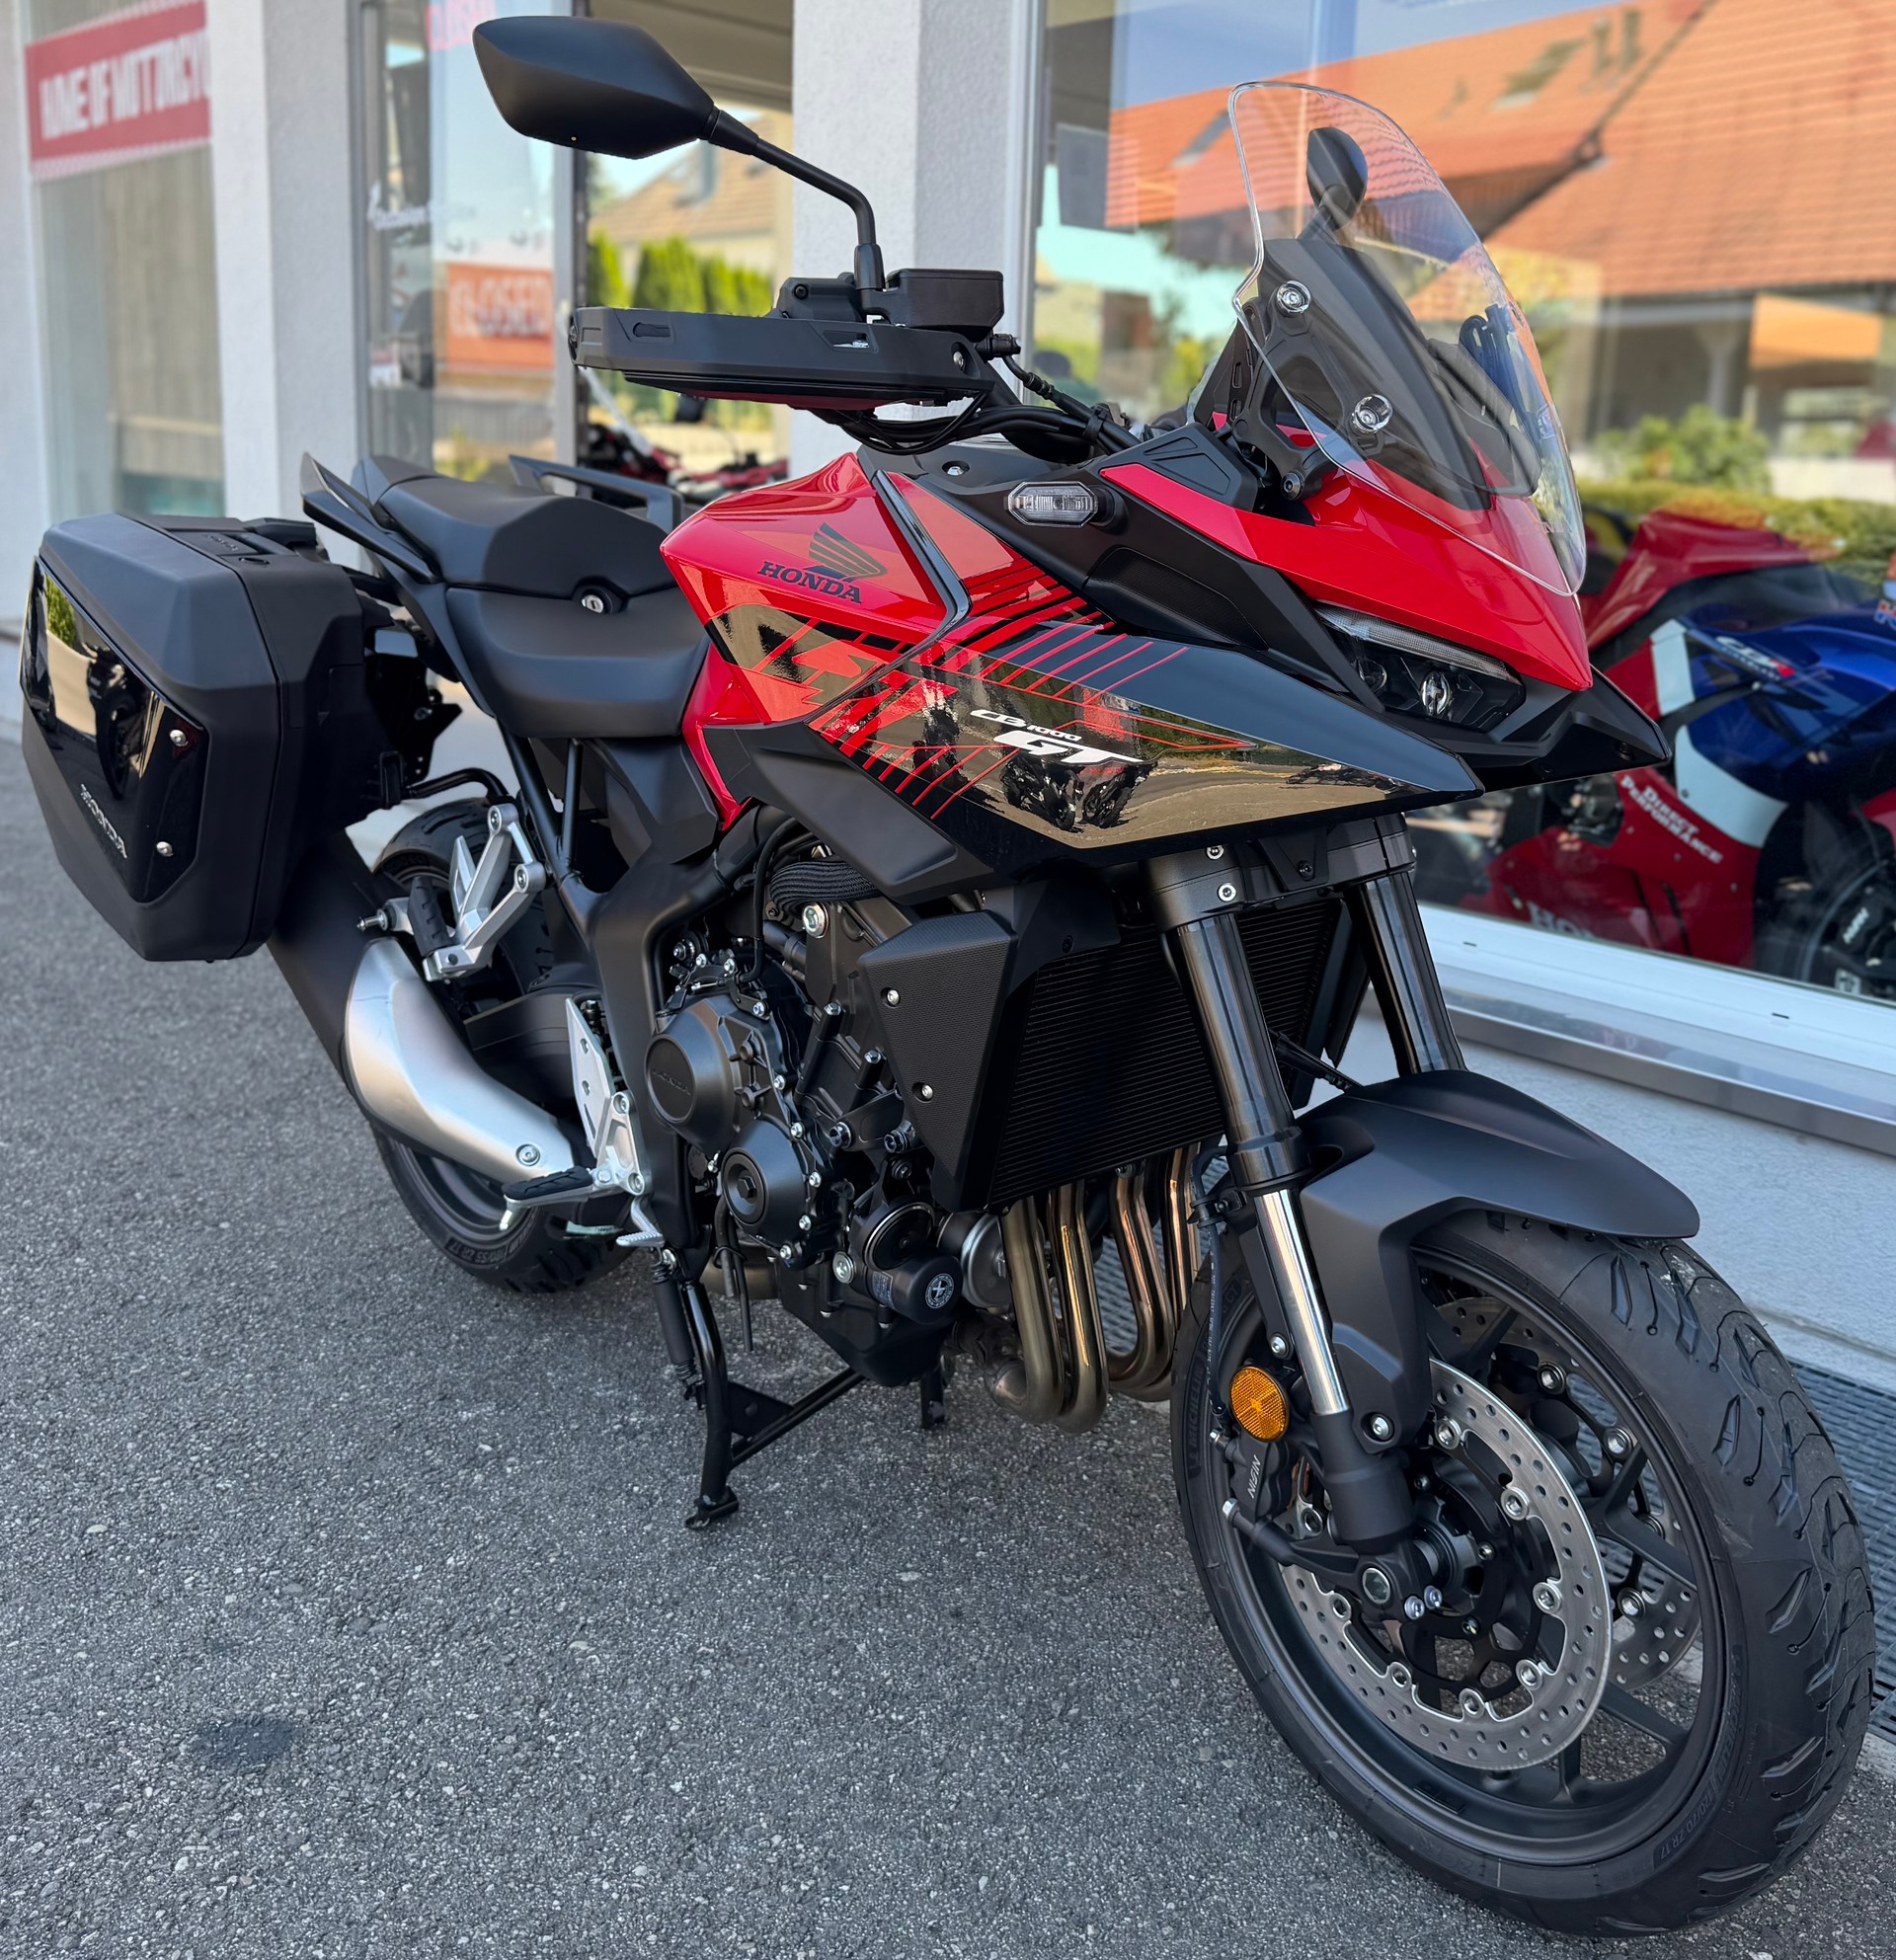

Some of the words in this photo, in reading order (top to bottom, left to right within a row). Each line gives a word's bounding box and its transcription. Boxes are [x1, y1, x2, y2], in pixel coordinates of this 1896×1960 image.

[756, 561, 862, 604] HONDA
[993, 730, 1145, 764] GT
[81, 783, 127, 859] HONDA
[1620, 774, 1723, 865] PERFORMANCE
[1642, 785, 1699, 834] DIRECT
[1687, 1790, 1714, 1833] 120/70
[1660, 1845, 1672, 1860] 17
[1672, 1832, 1687, 1849] ZR
